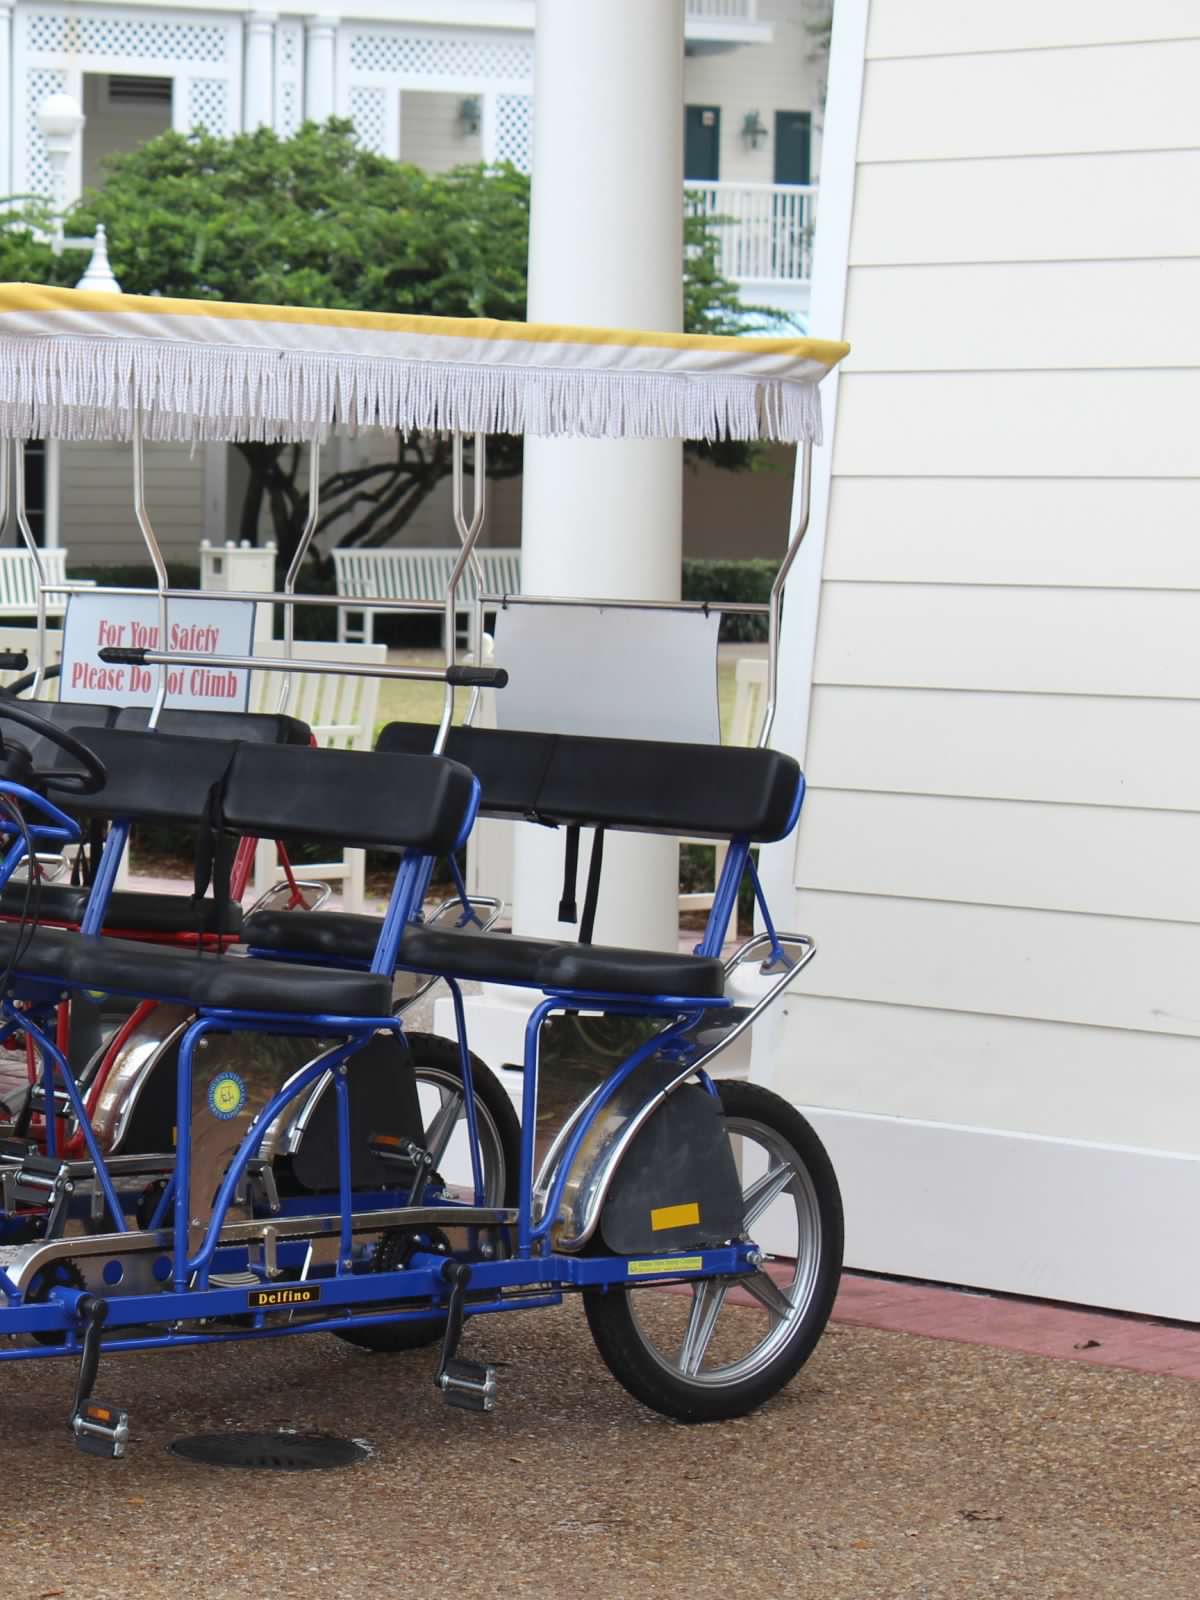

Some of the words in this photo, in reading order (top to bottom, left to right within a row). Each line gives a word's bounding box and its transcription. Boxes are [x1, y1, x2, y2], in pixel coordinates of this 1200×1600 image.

[97, 619, 126, 647] For
[131, 621, 161, 649] You
[169, 623, 220, 654] Safety
[71, 662, 125, 692] Please
[128, 665, 152, 693] Do
[167, 669, 184, 695] ot
[190, 668, 238, 699] Climb
[258, 1290, 311, 1305] Delfino
